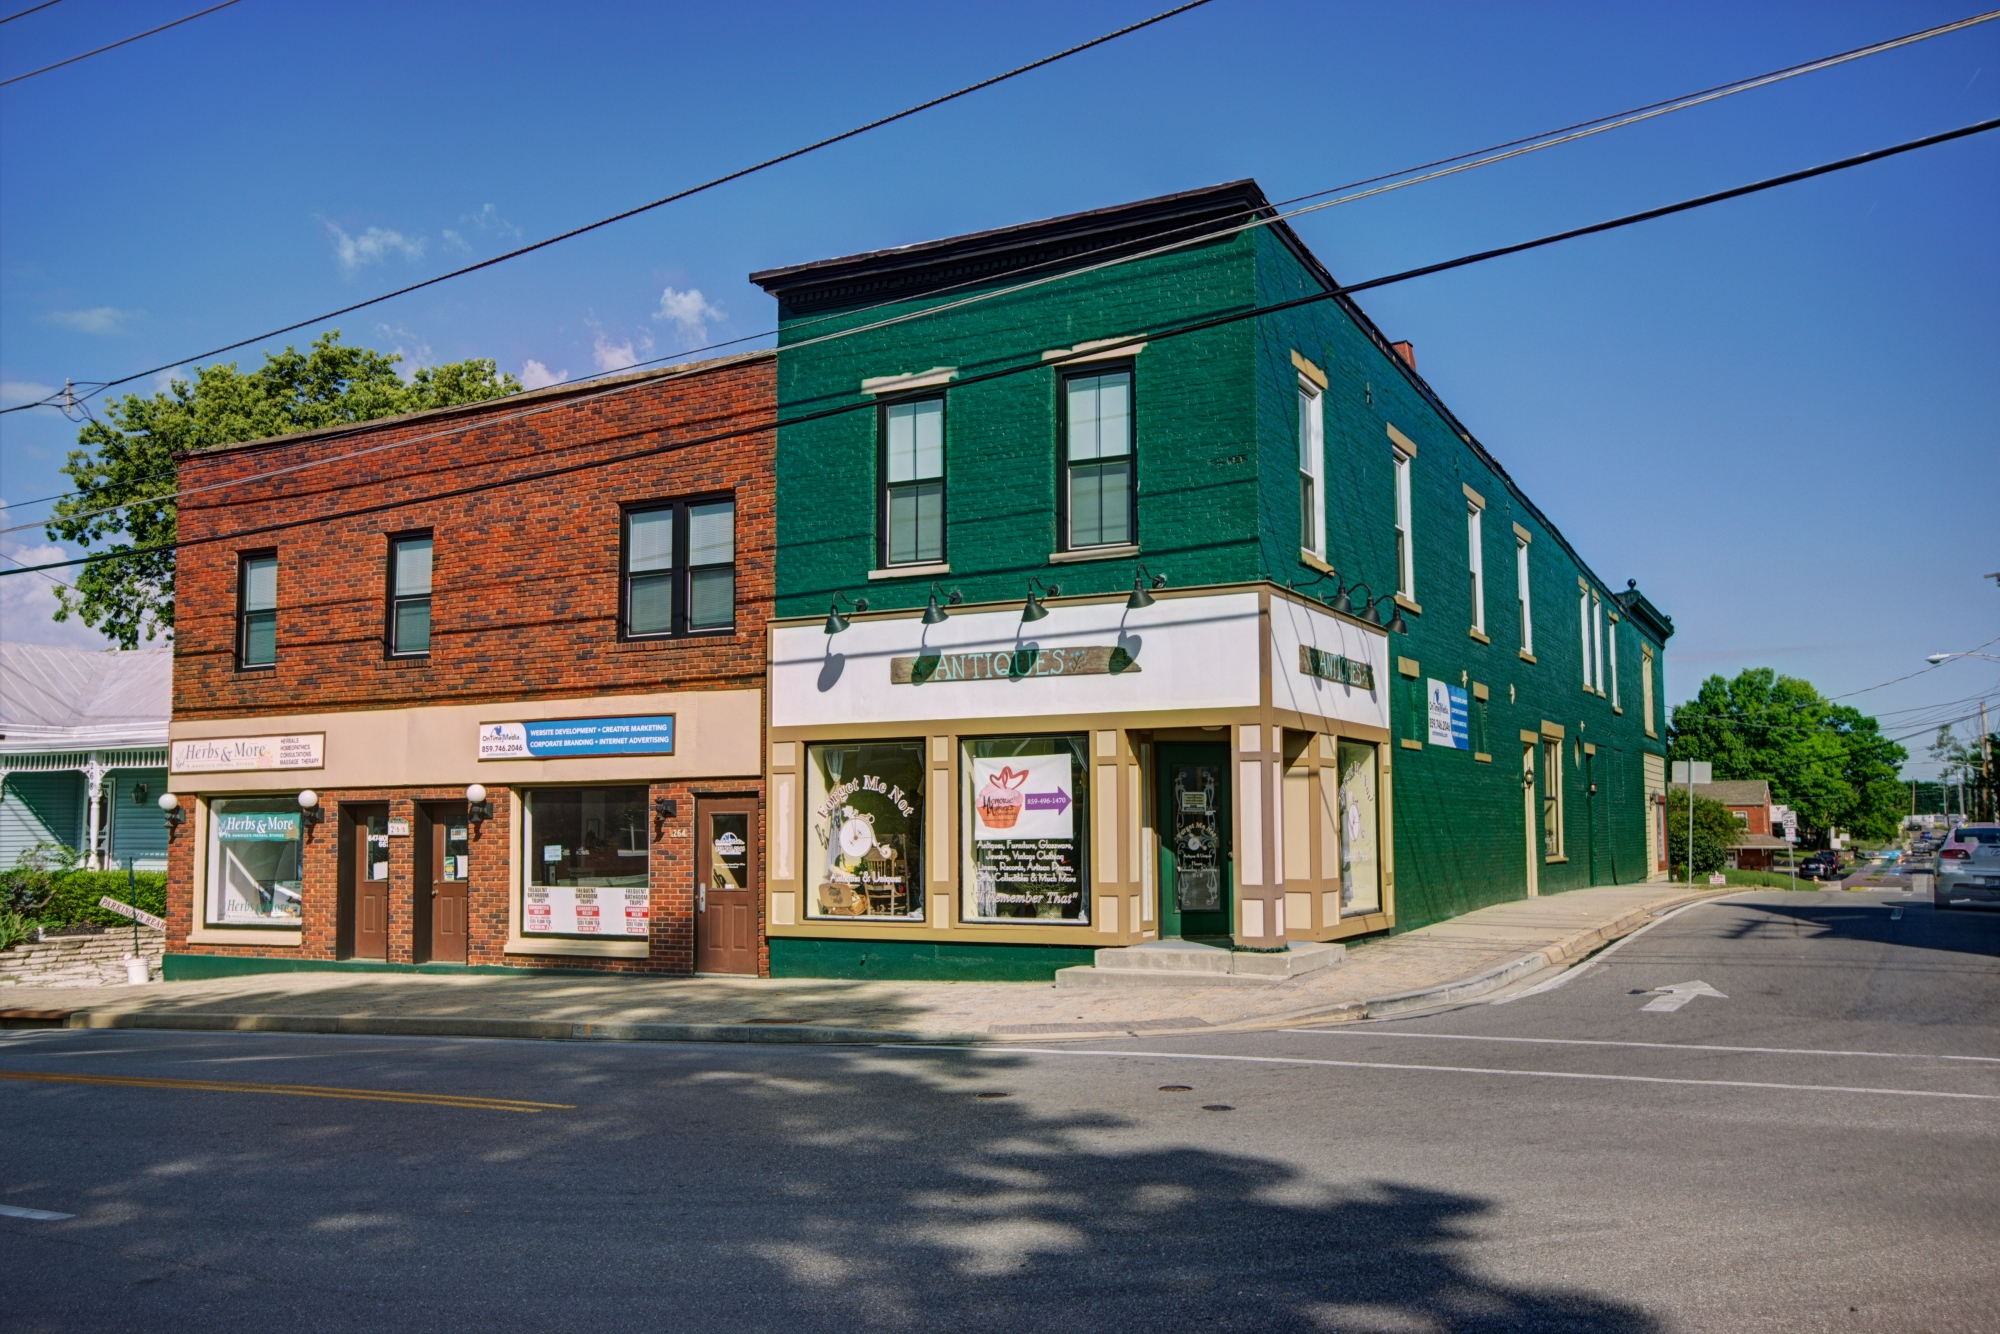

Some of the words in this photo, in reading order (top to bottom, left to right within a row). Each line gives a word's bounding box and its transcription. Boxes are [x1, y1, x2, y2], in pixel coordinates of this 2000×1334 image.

[934, 649, 1065, 681] ANTIQUES
[1318, 650, 1362, 684] ANTIQUES
[530, 729, 554, 737] WEBSITE
[555, 727, 597, 736] DEVELOPMENT
[602, 725, 630, 733] CREATIVE
[630, 724, 667, 732] MARKETING
[481, 744, 523, 753] 859.746.2046
[530, 740, 562, 748] CORPORATE
[563, 739, 594, 747] BRANDING
[599, 737, 629, 745] INTERNET
[629, 736, 669, 744] ADVERTISING
[185, 742, 219, 760] Herbs
[220, 746, 233, 762] &
[235, 742, 266, 758] More
[816, 777, 860, 820] Forget
[862, 774, 888, 794] Me
[887, 785, 914, 818] Not
[1027, 797, 1066, 805] 859-496-1470
[227, 815, 256, 831] Herbs
[256, 819, 267, 834] &
[267, 816, 294, 830] More
[390, 825, 406, 833] 266
[673, 829, 686, 837] 264
[977, 840, 1005, 851] Antiques,
[1006, 840, 1037, 850] Furniture,
[1038, 840, 1073, 850] Glassware,
[985, 851, 1011, 861] Jewelry,
[1012, 851, 1035, 861] Vintage
[1036, 851, 1064, 862] Clothing
[977, 862, 998, 872] Linens,
[999, 862, 1025, 872] Records,
[1027, 861, 1050, 871] Artisan
[1051, 862, 1074, 872] Pieces,
[830, 871, 860, 887] Antiques
[862, 871, 871, 882] &
[871, 871, 902, 885] Uniques
[994, 872, 1029, 882] Collectibles
[1030, 873, 1037, 882] &
[1038, 873, 1057, 882] Much
[1058, 873, 1077, 883] More
[987, 891, 1044, 904] Remember
[227, 899, 254, 912] Herbs
[101, 898, 135, 917] PARKING
[135, 911, 144, 921] IN
[145, 916, 167, 930] REAR
